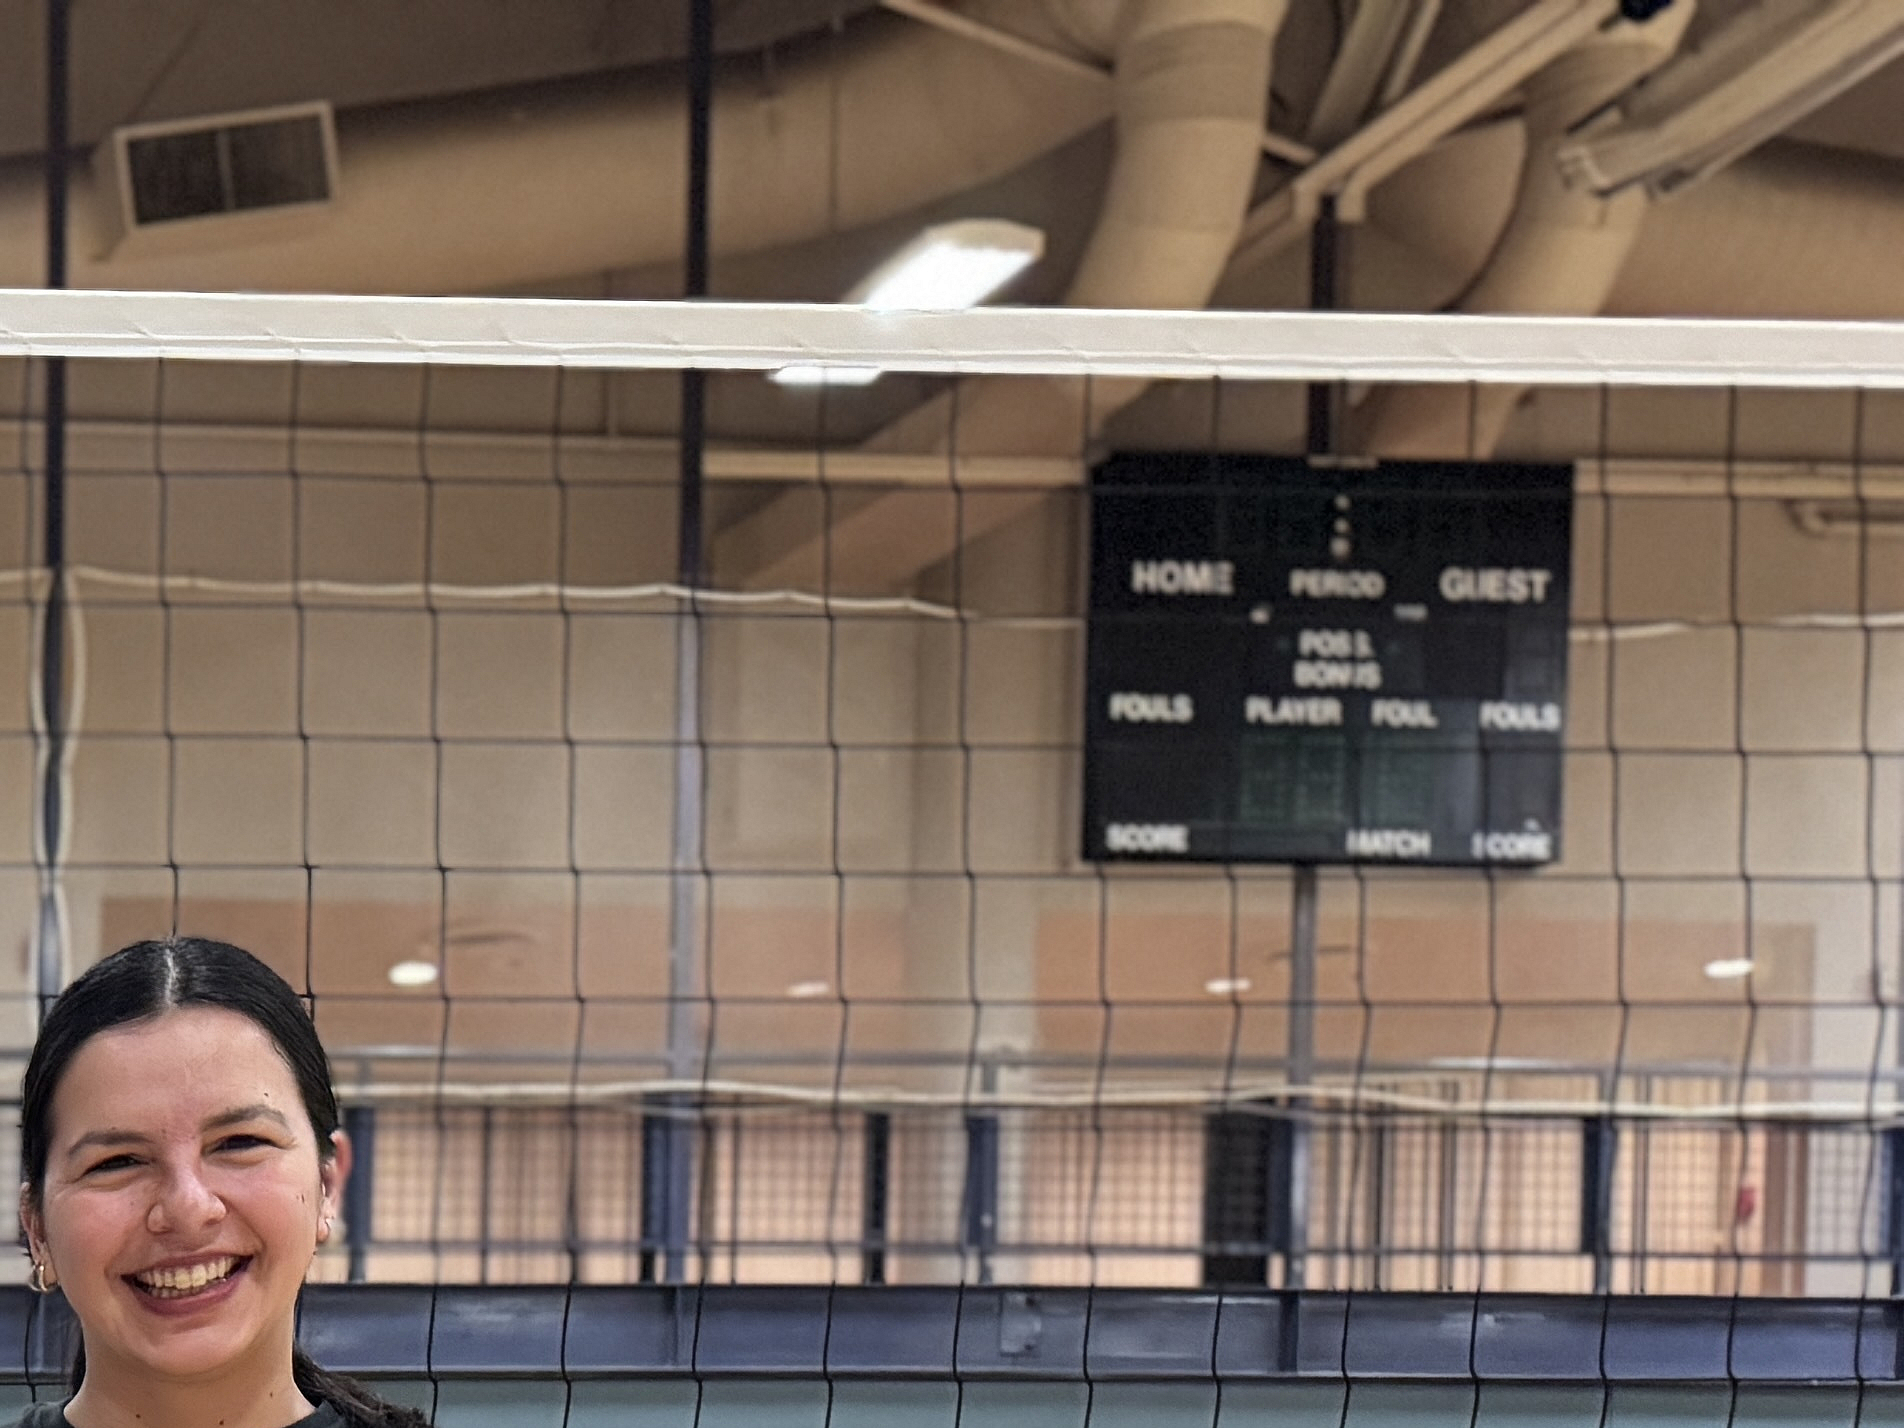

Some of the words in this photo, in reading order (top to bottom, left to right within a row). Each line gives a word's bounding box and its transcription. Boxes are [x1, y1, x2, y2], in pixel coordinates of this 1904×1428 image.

[1132, 560, 1235, 596] HOME
[1290, 569, 1387, 598] PERIOD
[1439, 566, 1552, 603] GUEST
[1293, 660, 1382, 690] BONUS
[1109, 693, 1193, 723] FOULS
[1245, 695, 1343, 726] PLAYER
[1370, 699, 1439, 728] FOUL
[1478, 701, 1563, 731] FOULS
[1106, 823, 1190, 853] SCORE
